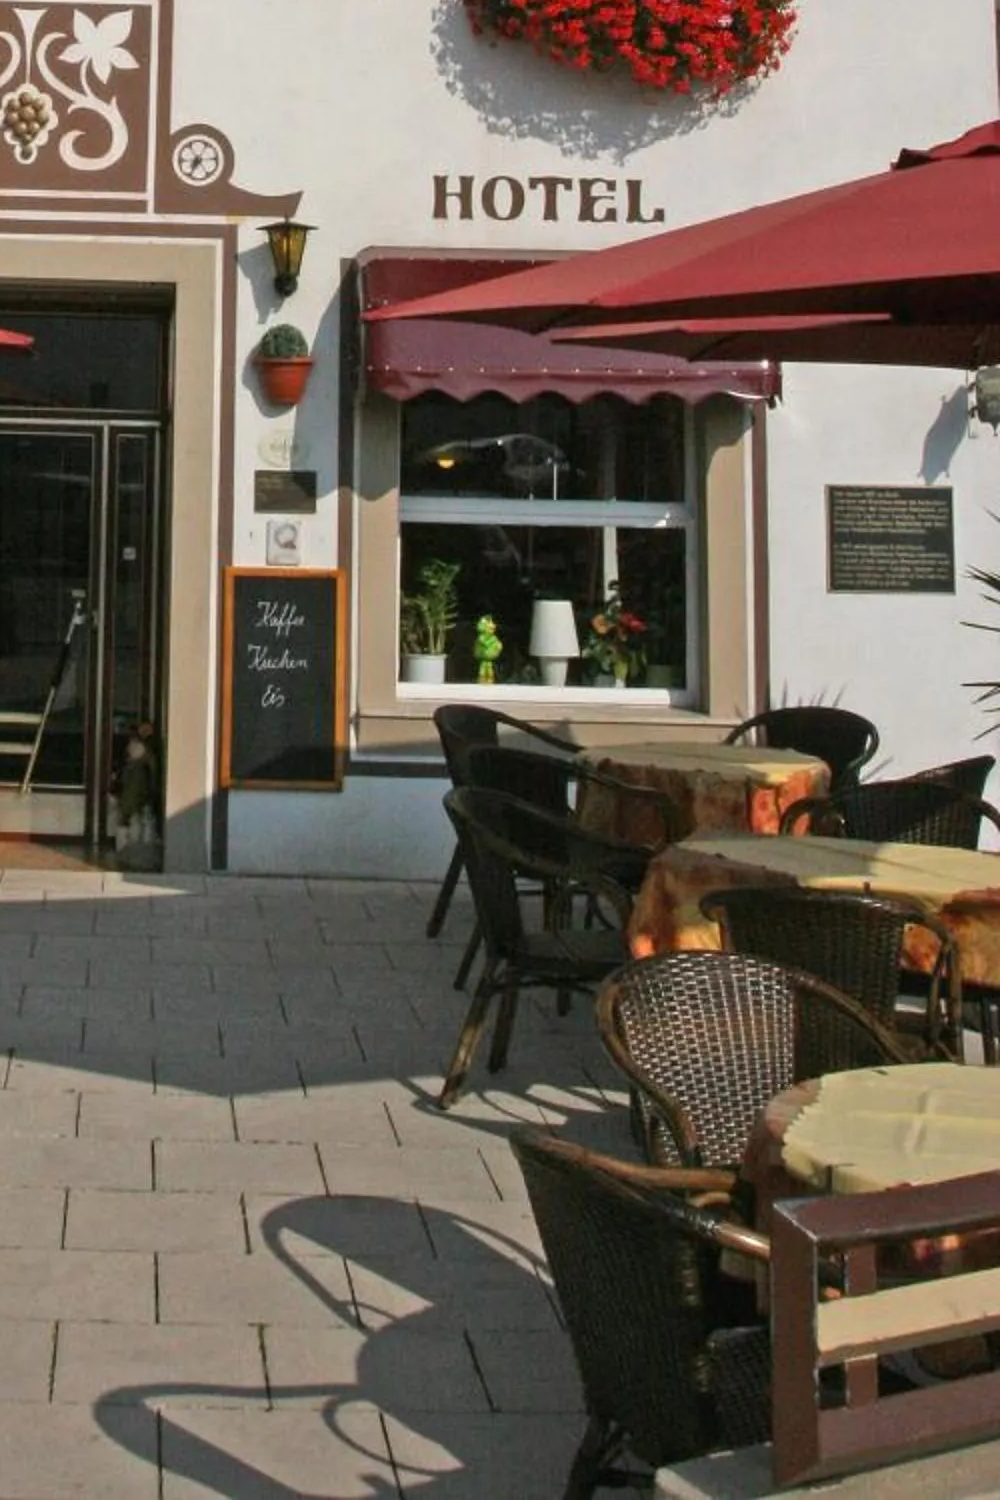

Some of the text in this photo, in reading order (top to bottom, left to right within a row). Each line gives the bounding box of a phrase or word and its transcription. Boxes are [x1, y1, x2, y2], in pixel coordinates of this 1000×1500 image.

[431, 174, 665, 223] HOTEL
[247, 643, 308, 672] Kuchen
[261, 683, 286, 708] Eis
